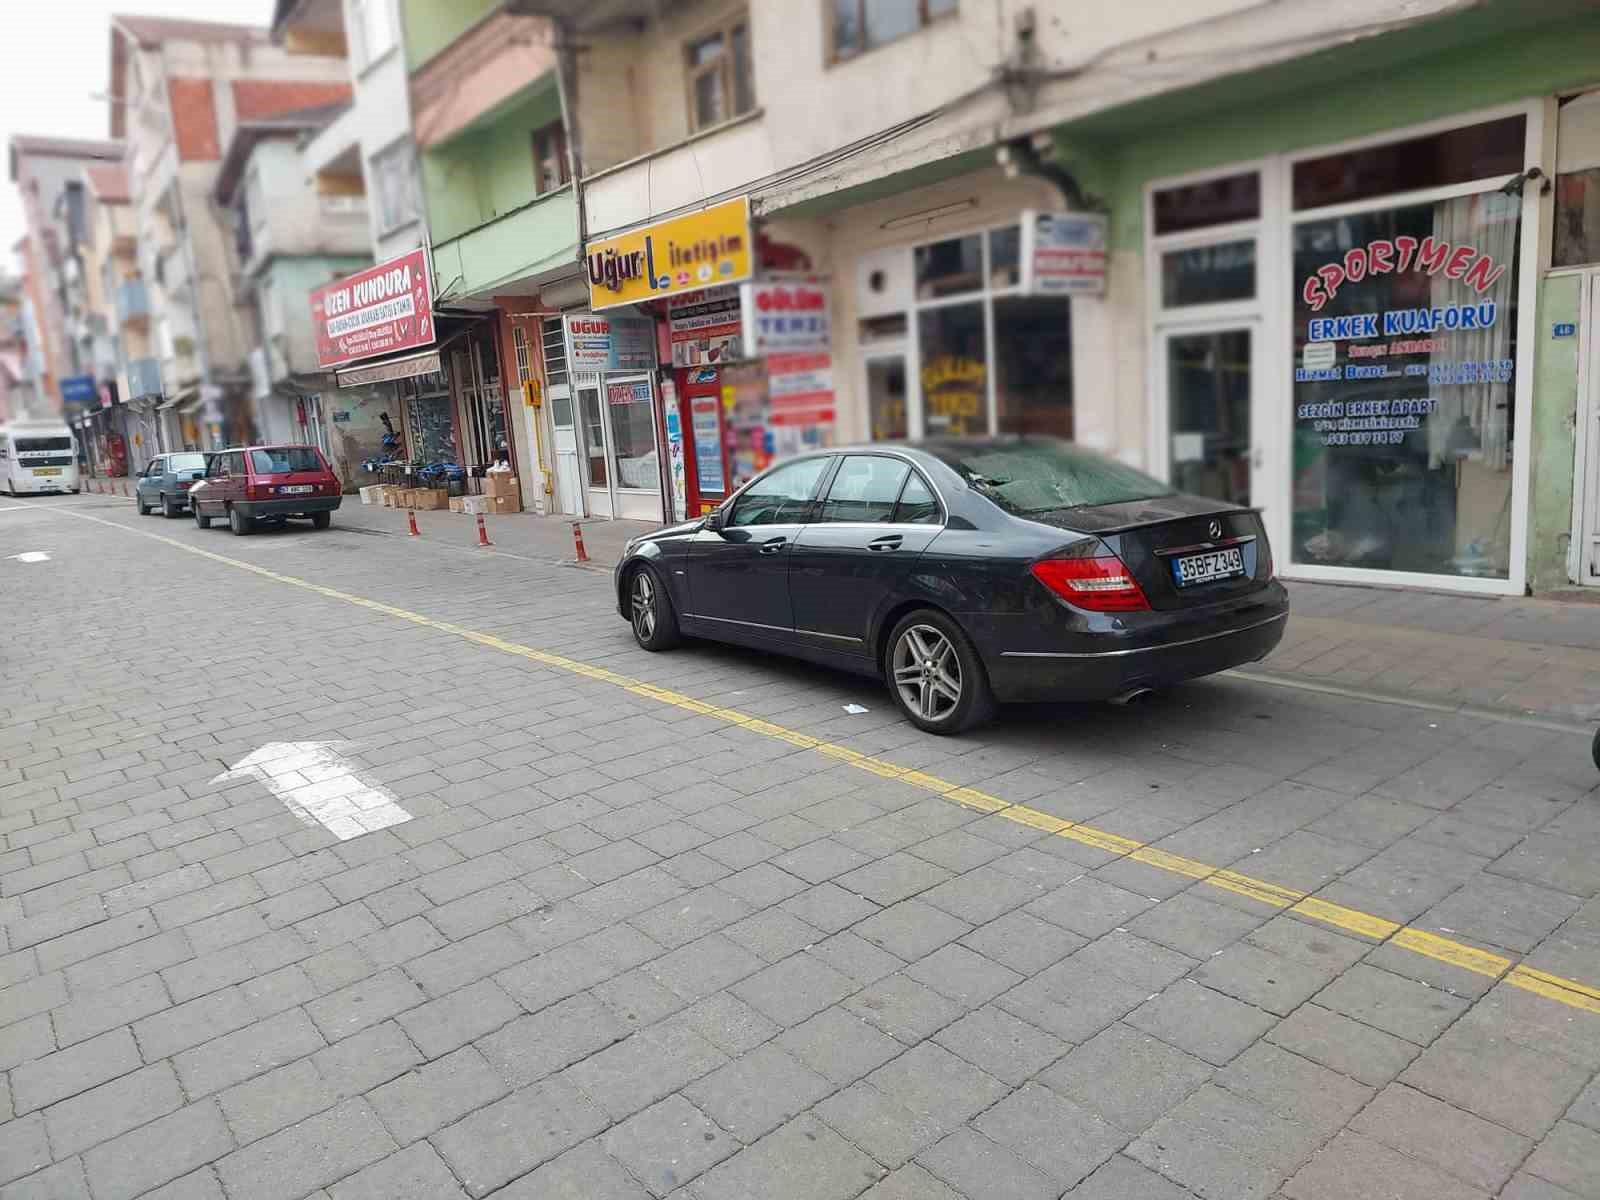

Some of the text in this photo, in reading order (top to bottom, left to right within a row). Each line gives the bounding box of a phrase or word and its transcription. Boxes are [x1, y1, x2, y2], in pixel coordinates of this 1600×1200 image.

[353, 265, 411, 308] KUNDURA
[588, 247, 643, 292] Uğur
[1303, 236, 1506, 312] SPORTMEN
[1309, 299, 1497, 342] ERKEK KUAFÖRÜ
[1298, 398, 1438, 418] SEZGİN ERKEK APART
